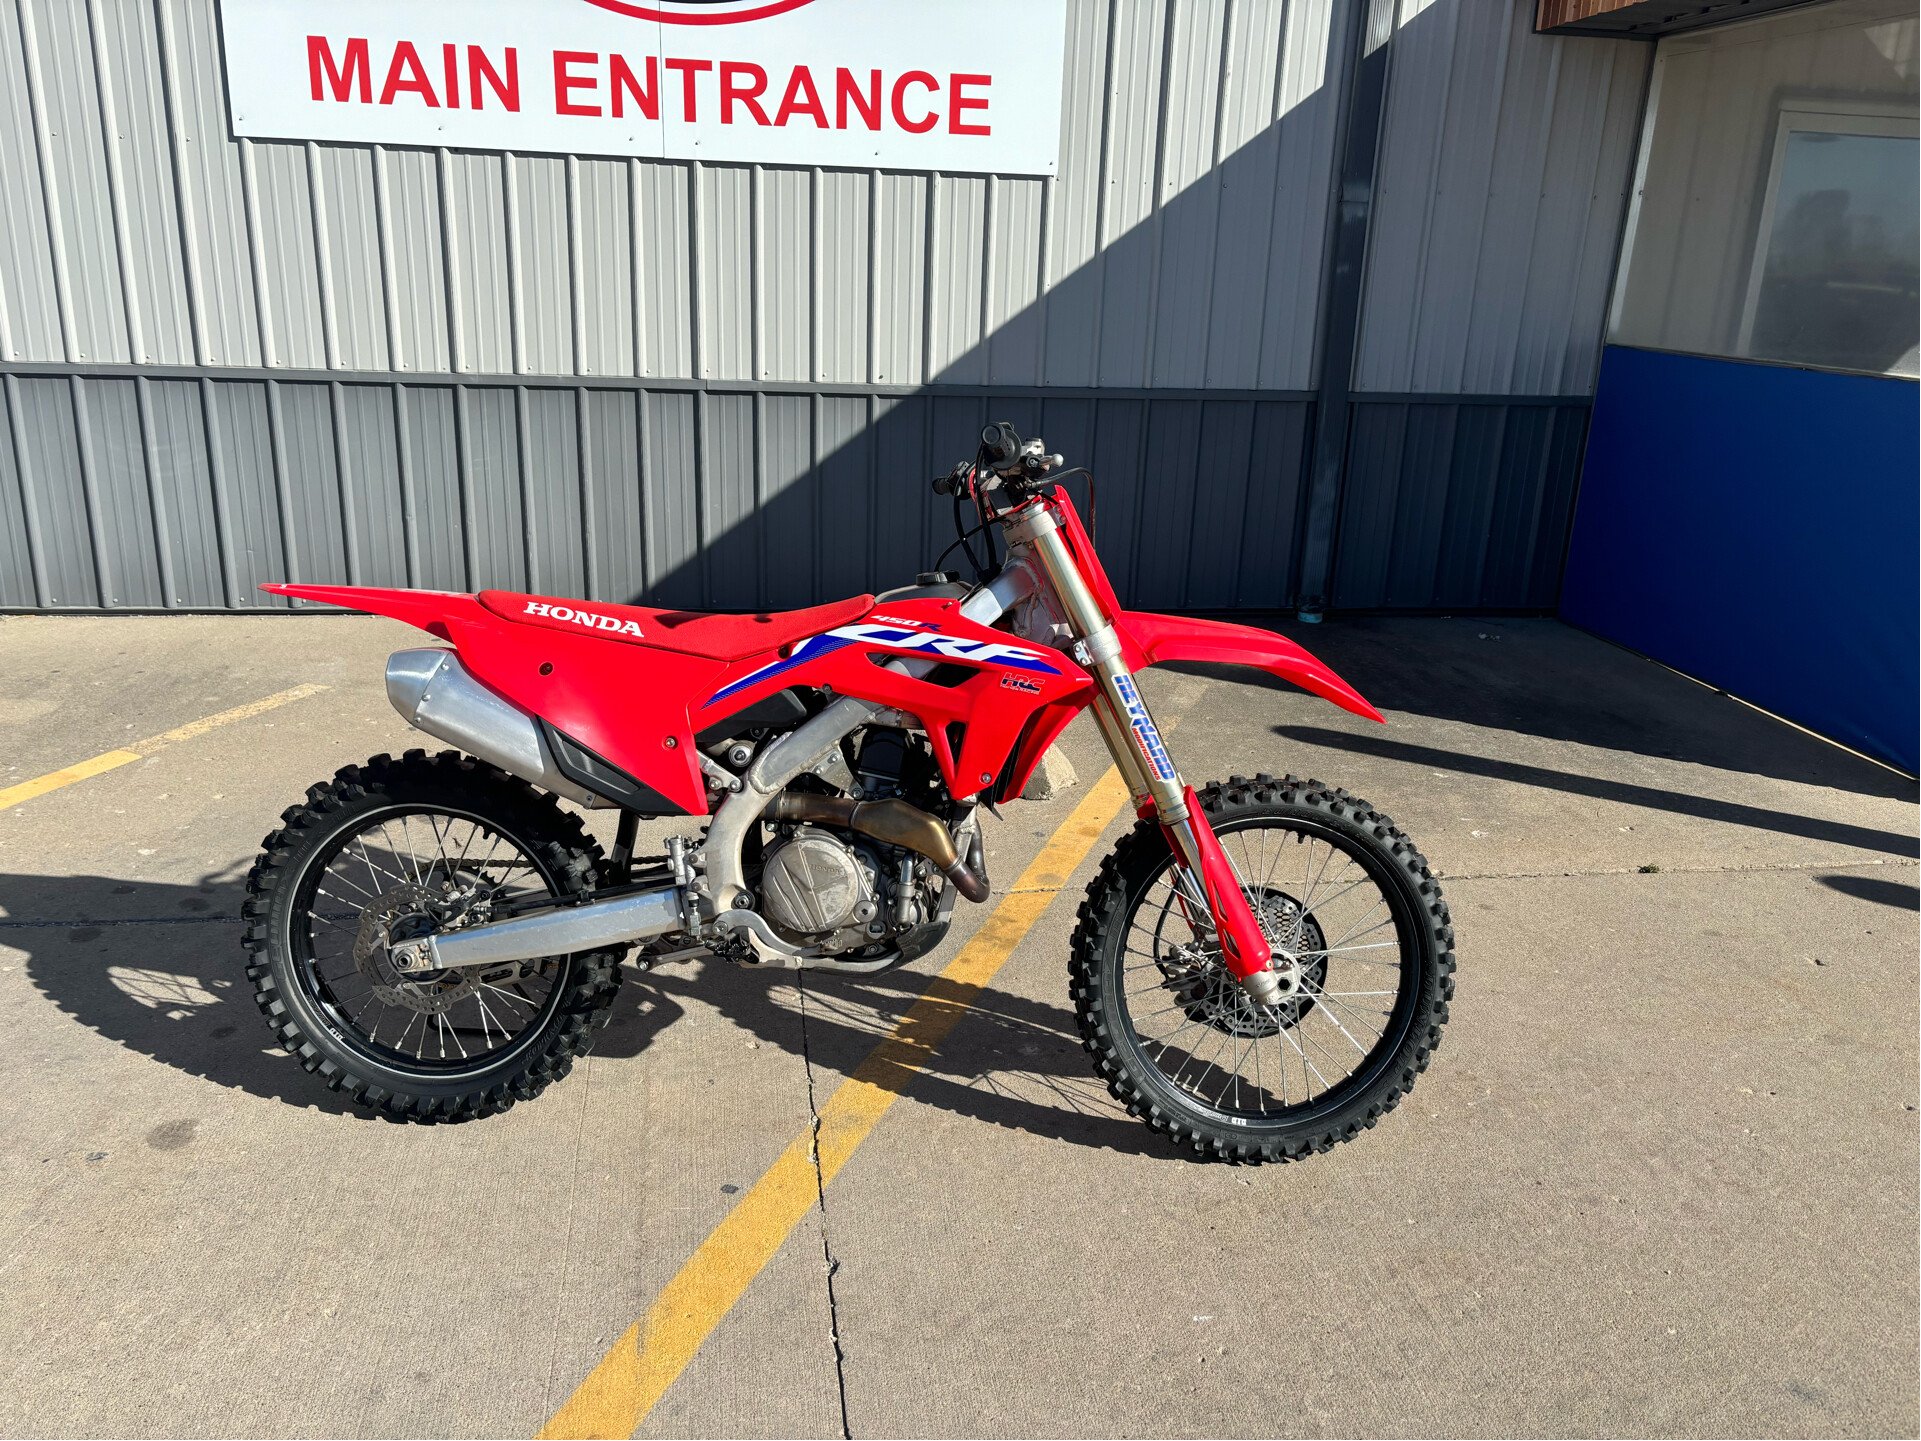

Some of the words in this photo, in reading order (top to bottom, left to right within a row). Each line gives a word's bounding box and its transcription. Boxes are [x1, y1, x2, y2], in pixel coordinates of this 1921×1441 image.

[307, 36, 519, 113] MAIN
[553, 50, 992, 136] ENTRANCE
[523, 601, 645, 638] HONDA
[871, 615, 943, 632] 450R
[824, 623, 1051, 661] CRF
[1001, 671, 1046, 692] HRC
